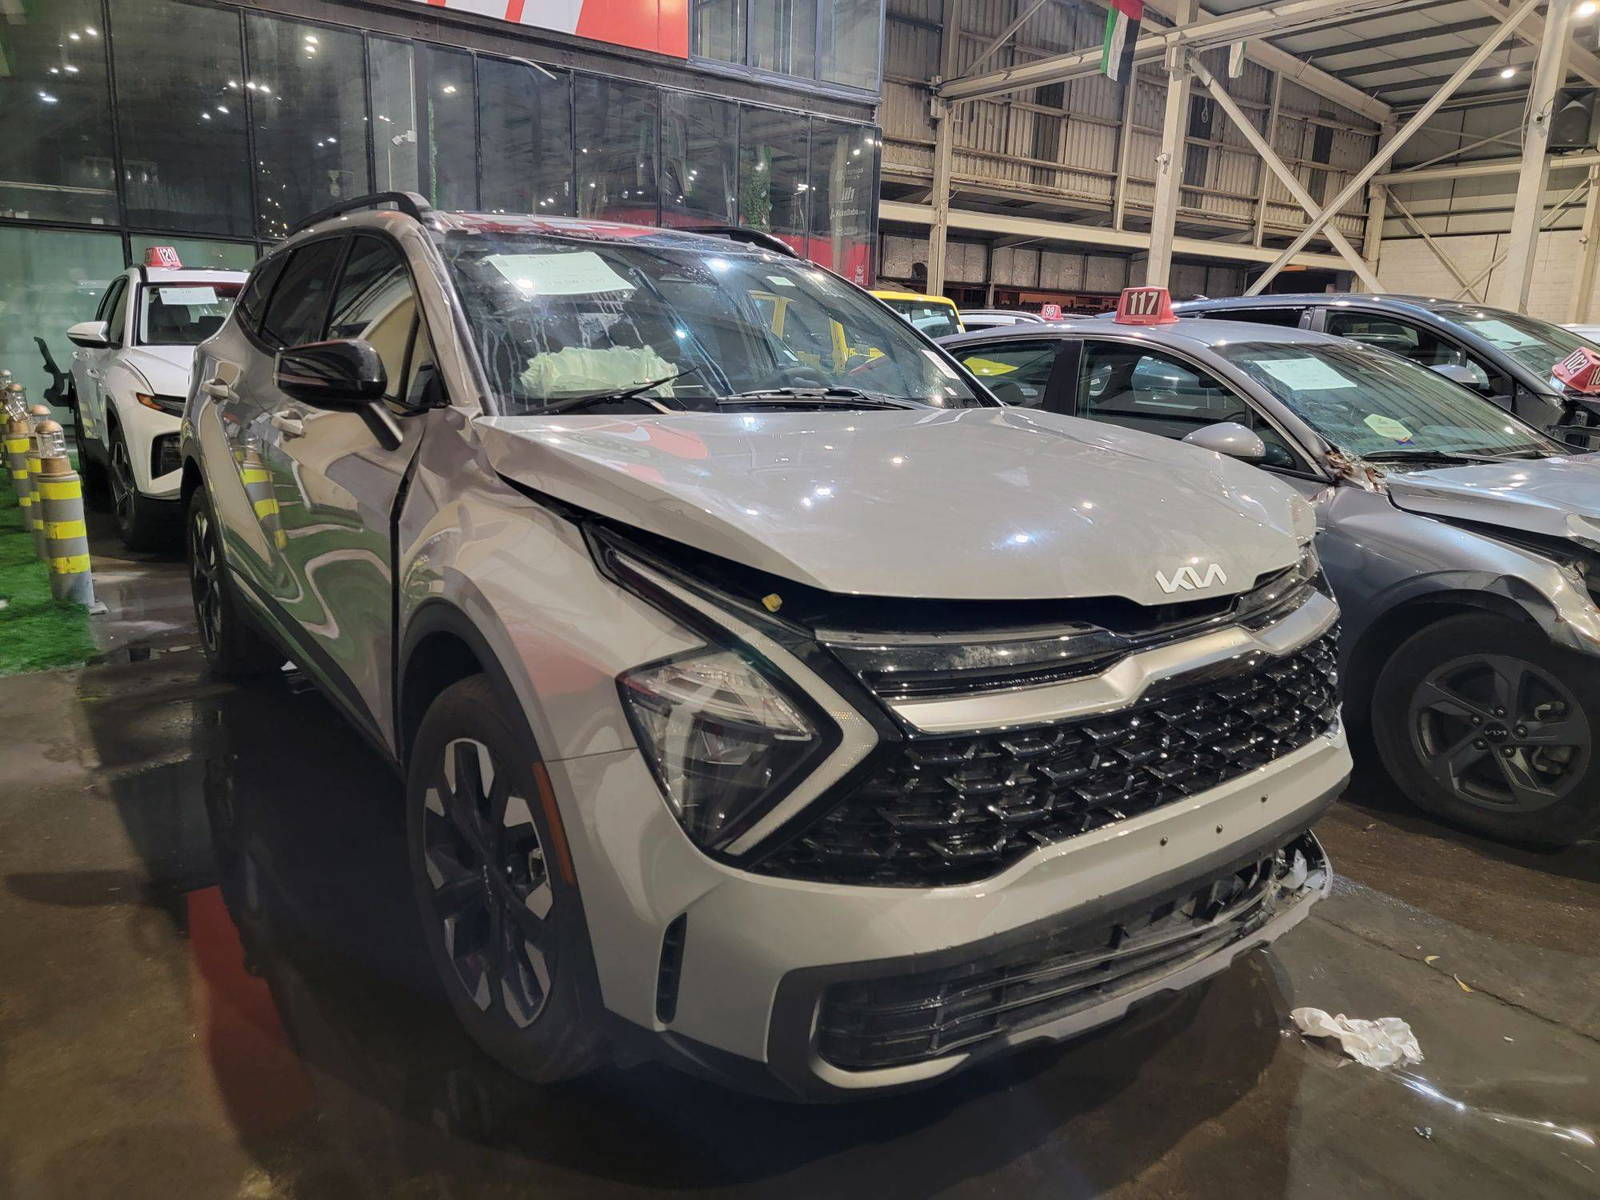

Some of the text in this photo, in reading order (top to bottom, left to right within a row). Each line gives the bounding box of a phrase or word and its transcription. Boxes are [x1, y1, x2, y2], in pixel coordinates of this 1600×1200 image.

[159, 248, 177, 262] 120
[1130, 291, 1159, 315] 117
[1564, 352, 1588, 375] 102
[1154, 563, 1228, 594] KIA
